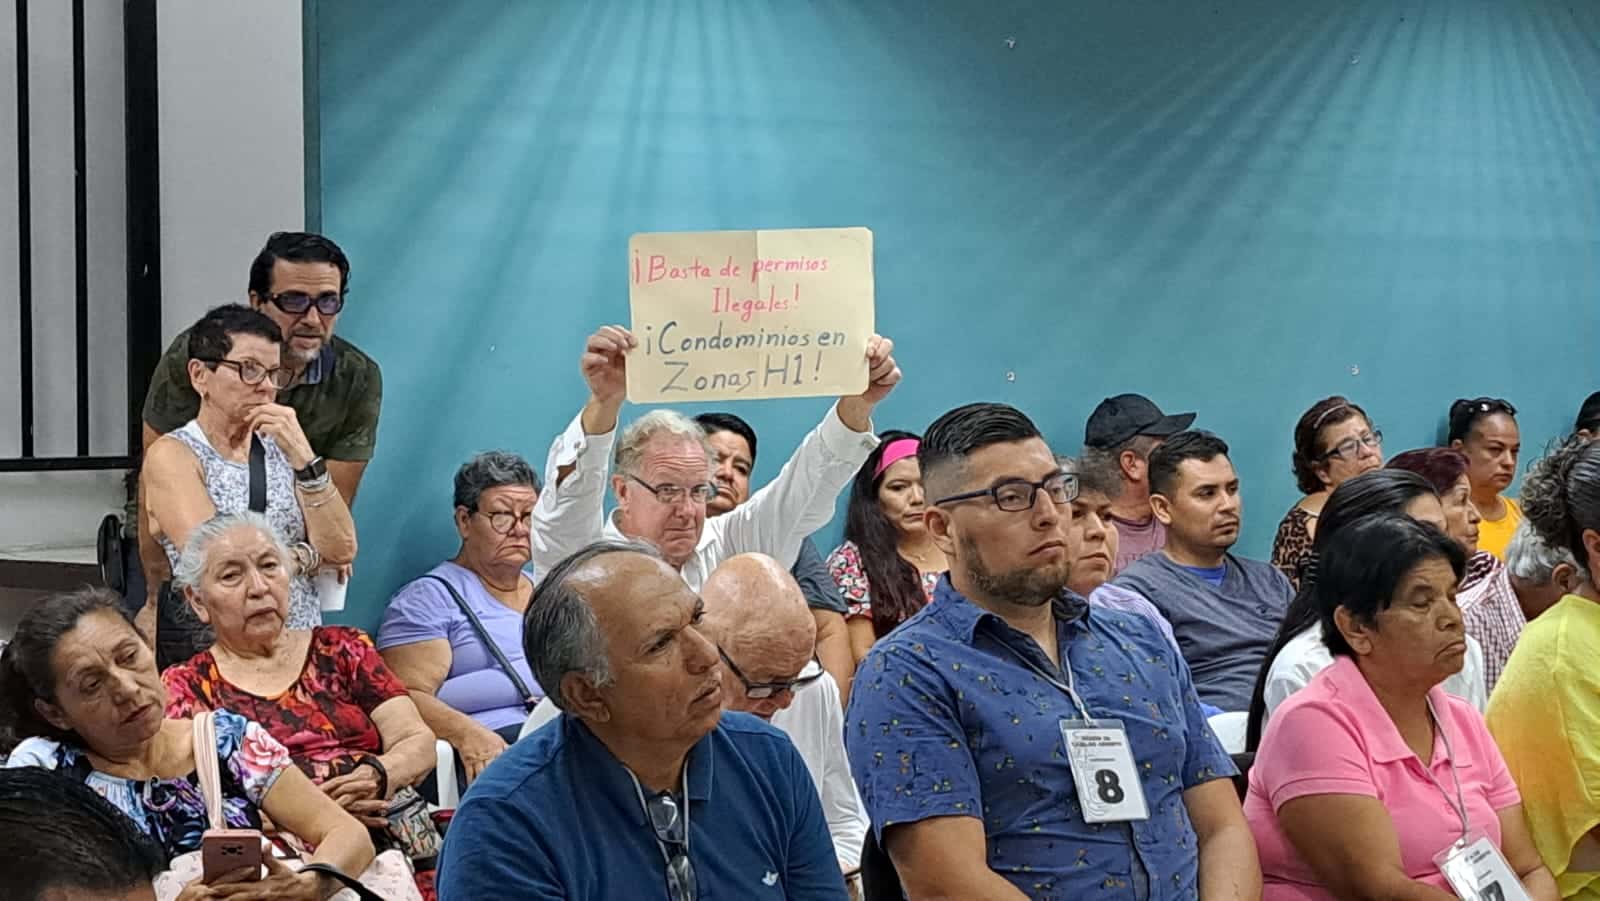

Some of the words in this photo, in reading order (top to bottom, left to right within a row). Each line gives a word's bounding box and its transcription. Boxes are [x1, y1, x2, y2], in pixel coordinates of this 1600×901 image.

[634, 250, 711, 283] ¡Basta
[720, 256, 741, 278] de
[751, 256, 828, 283] permisos
[712, 283, 800, 322] Ilegales!
[645, 320, 811, 355] ¡Condominios
[817, 330, 846, 347] en
[660, 360, 757, 393] Zonas
[1095, 768, 1125, 804] 8
